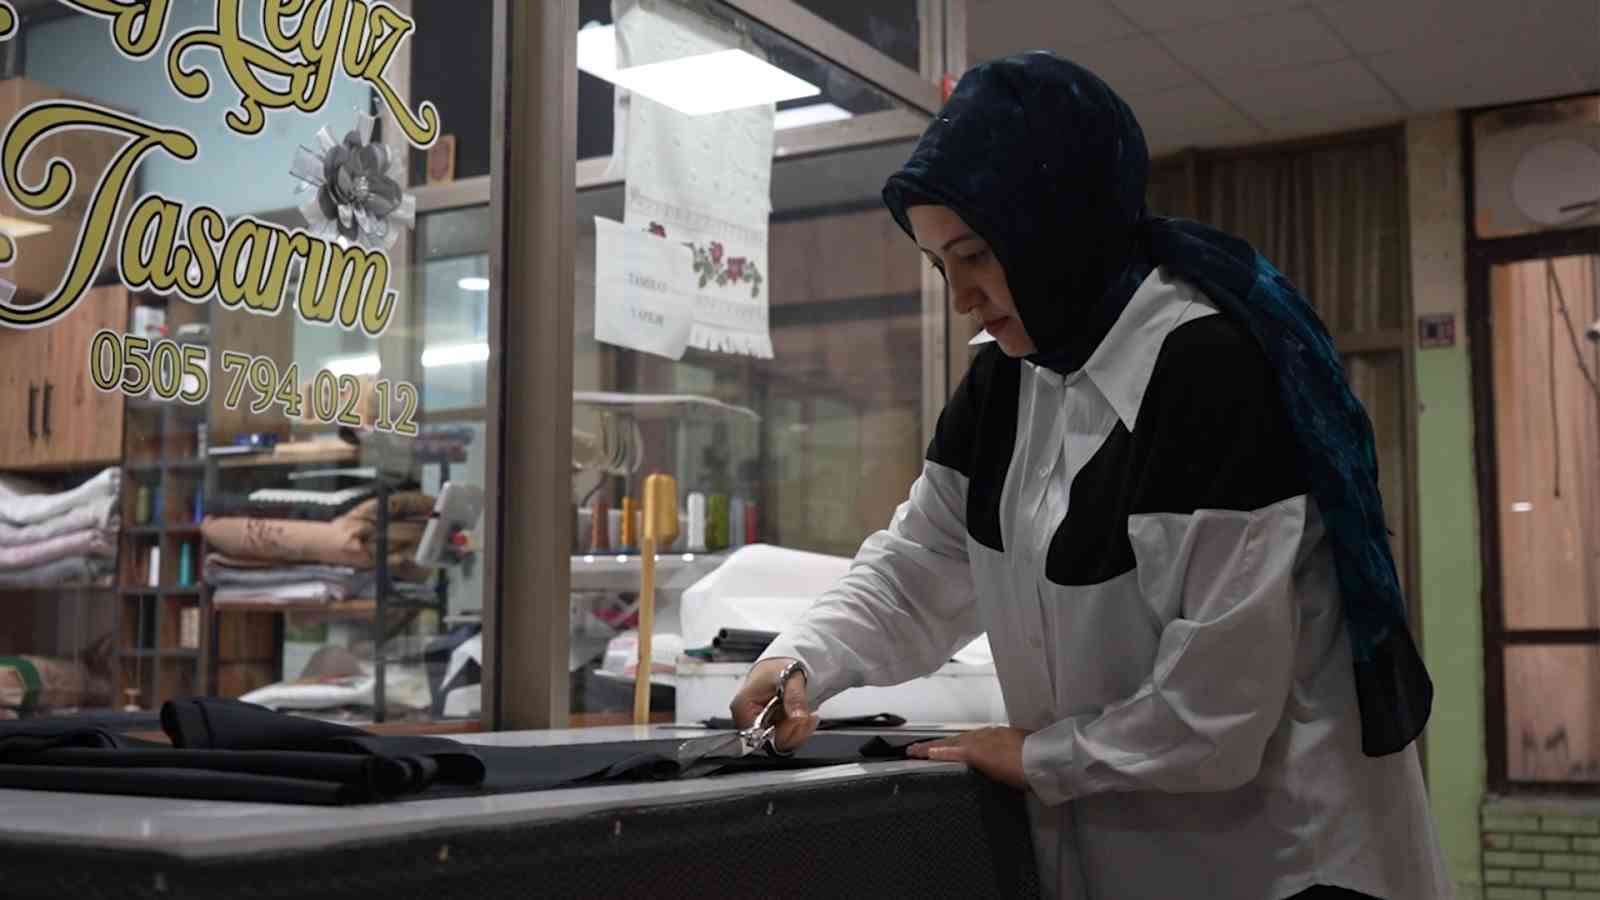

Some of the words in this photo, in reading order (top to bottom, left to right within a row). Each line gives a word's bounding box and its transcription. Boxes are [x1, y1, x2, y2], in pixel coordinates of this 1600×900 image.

[0, 99, 398, 335] Tasarım
[90, 330, 210, 403] 0505
[222, 351, 303, 418] 794
[312, 367, 362, 426] 02
[375, 378, 419, 436] 12
